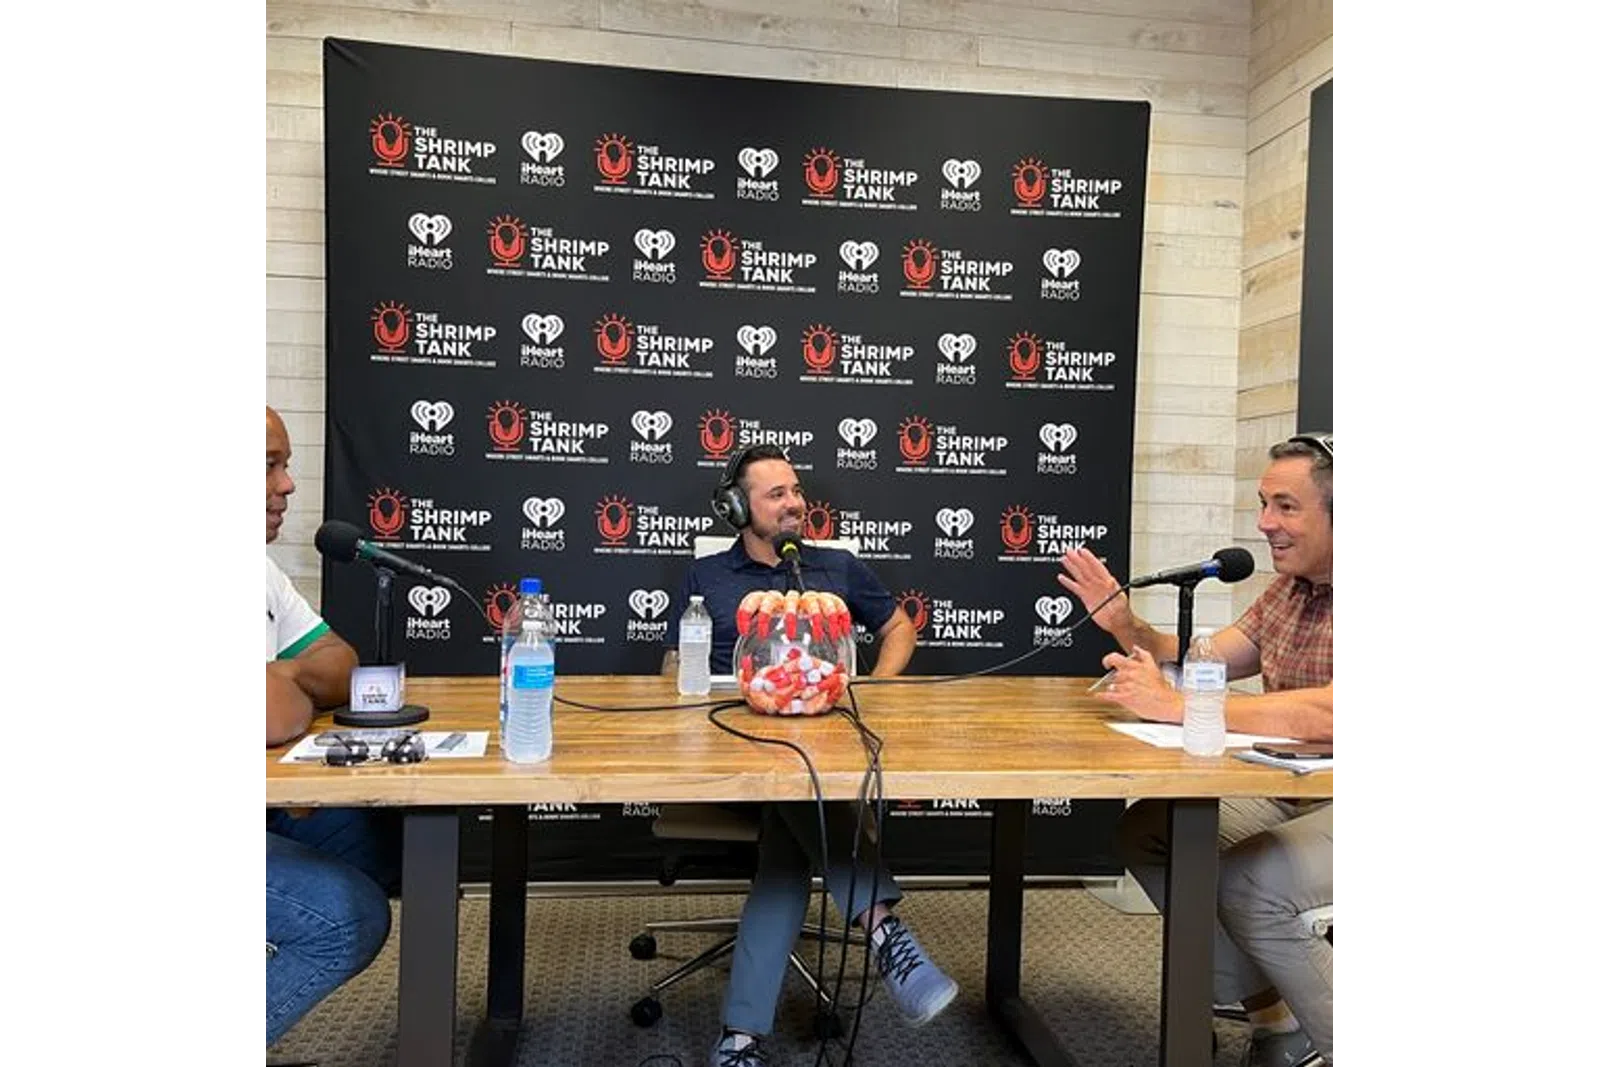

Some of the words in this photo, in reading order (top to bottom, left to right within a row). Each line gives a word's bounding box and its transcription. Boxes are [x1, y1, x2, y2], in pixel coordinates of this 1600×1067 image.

[415, 126, 437, 136] THE
[415, 136, 496, 157] SHRIMP
[638, 146, 658, 155] THE
[415, 155, 471, 173] TANK
[522, 163, 563, 176] iHeart
[637, 155, 714, 173] SHRIMP
[844, 159, 864, 168] THE
[521, 174, 565, 186] RADIO
[844, 168, 917, 186] SHRIMP
[1052, 169, 1071, 178] THE
[637, 172, 691, 189] TANK
[737, 177, 778, 190] iHeart
[1051, 177, 1121, 194] SHRIMP
[737, 189, 779, 201] RADIO
[844, 184, 894, 201] TANK
[941, 189, 980, 201] iHeart
[940, 199, 981, 211] RADIO
[1050, 193, 1099, 209] TANK
[532, 228, 552, 236] THE
[408, 245, 452, 258] iHeart
[531, 237, 609, 256] SHRIMP
[742, 241, 762, 251] THE
[741, 250, 816, 268] SHRIMP
[942, 250, 961, 259] THE
[408, 256, 453, 269] RADIO
[531, 254, 585, 271] TANK
[634, 259, 675, 273] iHeart
[941, 259, 1012, 275] SHRIMP
[633, 271, 676, 283] RADIO
[741, 267, 792, 283] TANK
[839, 270, 878, 283] iHeart
[838, 282, 879, 293] RADIO
[941, 274, 990, 291] TANK
[1042, 278, 1079, 290] iHeart
[1041, 288, 1080, 300] RADIO
[416, 313, 437, 322] THE
[416, 323, 496, 341] SHRIMP
[637, 325, 658, 334] THE
[637, 335, 713, 352] SHRIMP
[842, 335, 861, 344] THE
[1046, 342, 1065, 350] THE
[416, 340, 471, 357] TANK
[522, 345, 563, 358] iHeart
[841, 344, 914, 361] SHRIMP
[521, 356, 564, 368] RADIO
[637, 351, 690, 368] TANK
[737, 356, 777, 369] iHeart
[1045, 351, 1115, 367] SHRIMP
[736, 367, 777, 378] RADIO
[840, 360, 891, 376] TANK
[937, 363, 975, 375] iHeart
[1045, 366, 1093, 381] TANK
[936, 373, 976, 384] RADIO
[531, 411, 551, 420] THE
[530, 421, 608, 438] SHRIMP
[740, 420, 759, 428] THE
[938, 426, 956, 435] THE
[411, 433, 454, 446] iHeart
[739, 430, 813, 446] SHRIMP
[937, 436, 1007, 451] SHRIMP
[410, 443, 454, 455] RADIO
[530, 437, 584, 454] TANK
[631, 441, 672, 453] iHeart
[630, 451, 673, 463] RADIO
[837, 449, 876, 459] iHeart
[936, 451, 984, 466] TANK
[1039, 453, 1076, 465] iHeart
[837, 459, 877, 470] RADIO
[1038, 463, 1076, 474] RADIO
[411, 499, 434, 508] THE
[411, 509, 492, 526] SHRIMP
[638, 506, 658, 516] THE
[840, 511, 859, 519] THE
[637, 516, 713, 532] SHRIMP
[840, 522, 912, 536] SHRIMP
[411, 525, 466, 542] TANK
[522, 528, 565, 540] iHeart
[637, 531, 690, 547] TANK
[1038, 526, 1107, 539] SHRIMP
[521, 538, 565, 550] RADIO
[936, 538, 973, 549] iHeart
[935, 548, 973, 559] RADIO
[934, 600, 953, 609] THE
[408, 618, 450, 629] iHeart
[933, 610, 1004, 624] SHRIMP
[406, 627, 450, 639] RADIO
[933, 624, 984, 639] TANK
